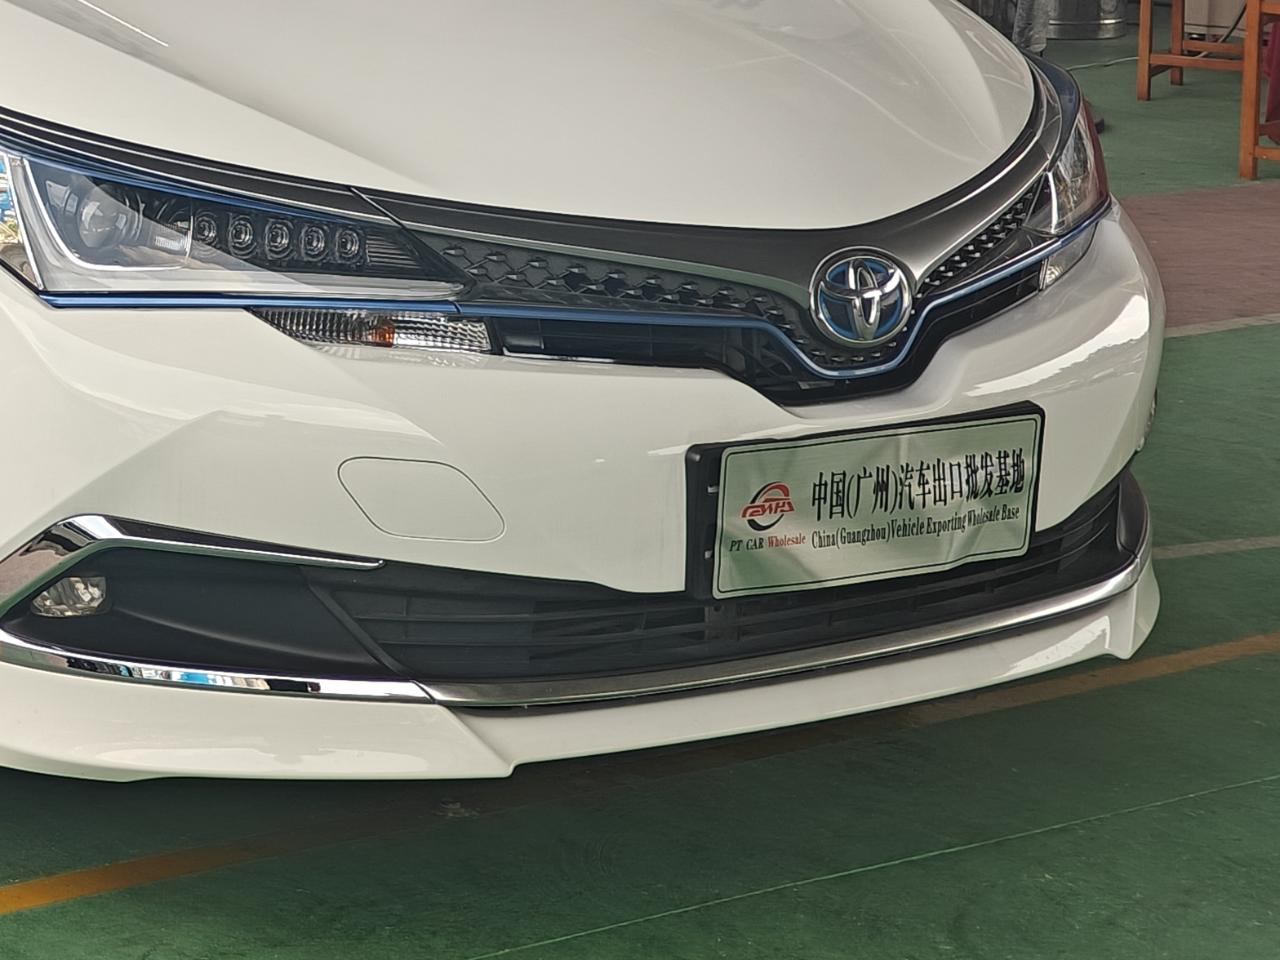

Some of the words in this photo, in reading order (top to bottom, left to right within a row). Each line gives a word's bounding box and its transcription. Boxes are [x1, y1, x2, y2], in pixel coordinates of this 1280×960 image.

[811, 447, 1025, 522] 中国(广州)汽车出口批发基地
[925, 511, 967, 537] Exporting
[1000, 503, 1020, 520] Base
